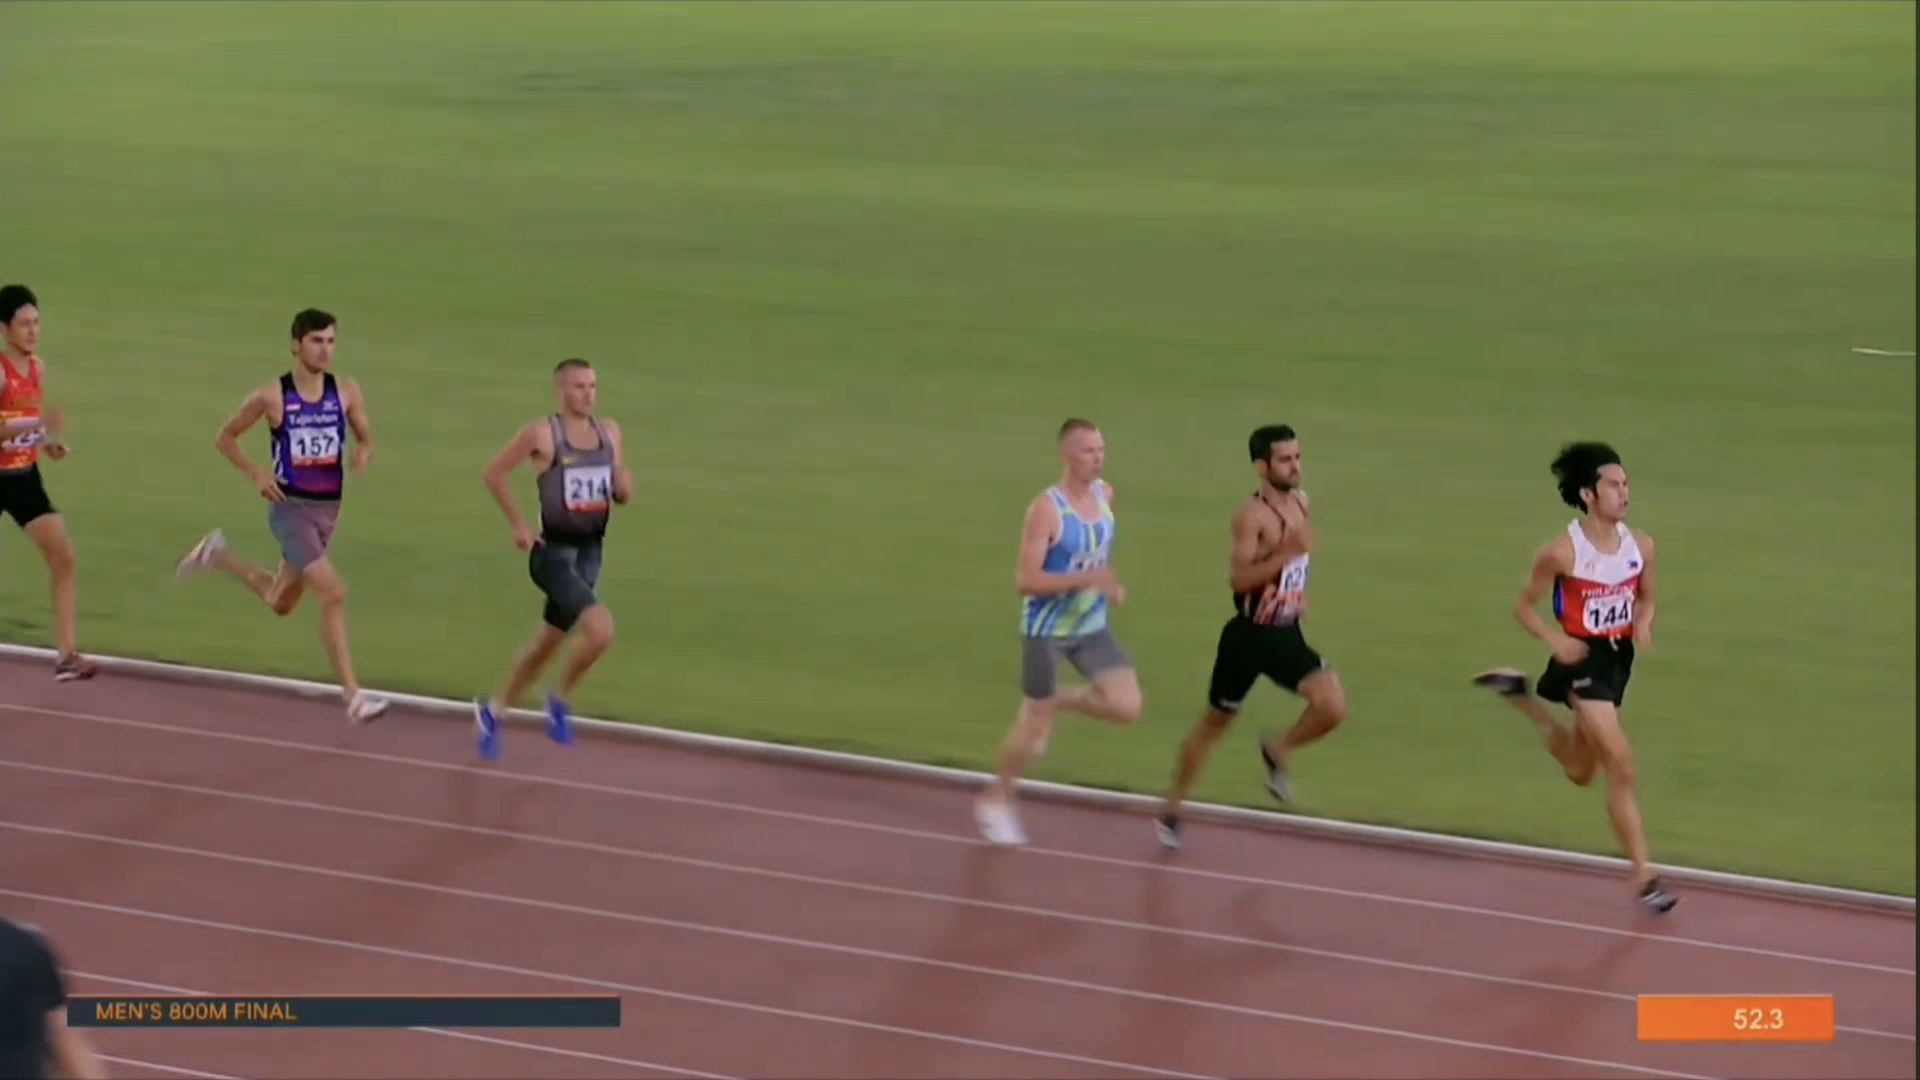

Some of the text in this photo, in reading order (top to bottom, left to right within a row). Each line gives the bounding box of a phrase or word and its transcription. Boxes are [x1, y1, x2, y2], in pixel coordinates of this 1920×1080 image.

[296, 433, 335, 456] 157
[570, 476, 608, 499] 214
[1589, 600, 1628, 628] 144
